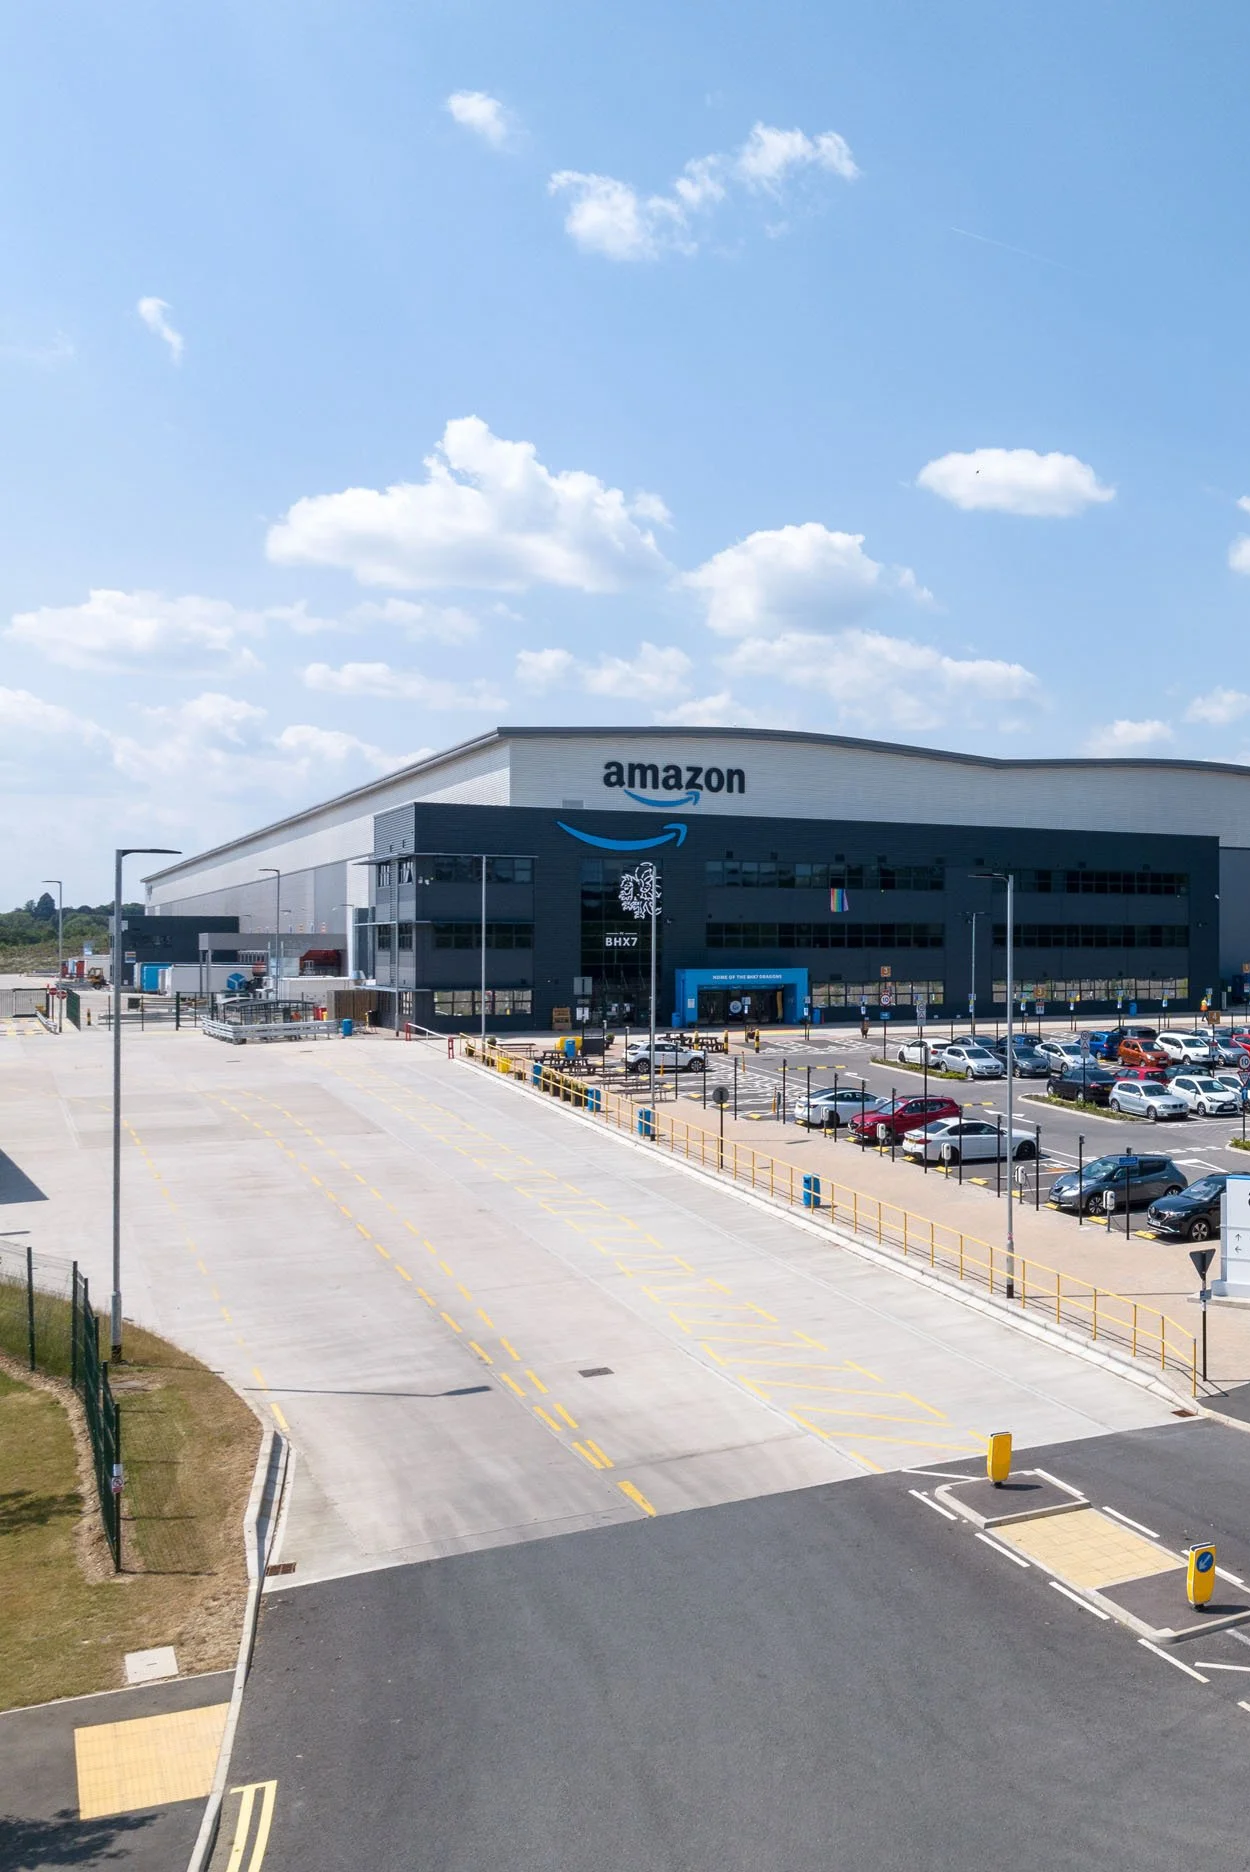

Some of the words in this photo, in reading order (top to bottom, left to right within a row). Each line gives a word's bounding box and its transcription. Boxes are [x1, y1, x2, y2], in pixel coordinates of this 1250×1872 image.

[603, 761, 746, 794] amazon
[605, 937, 638, 947] BHX7
[1241, 1058, 1249, 1066] 10
